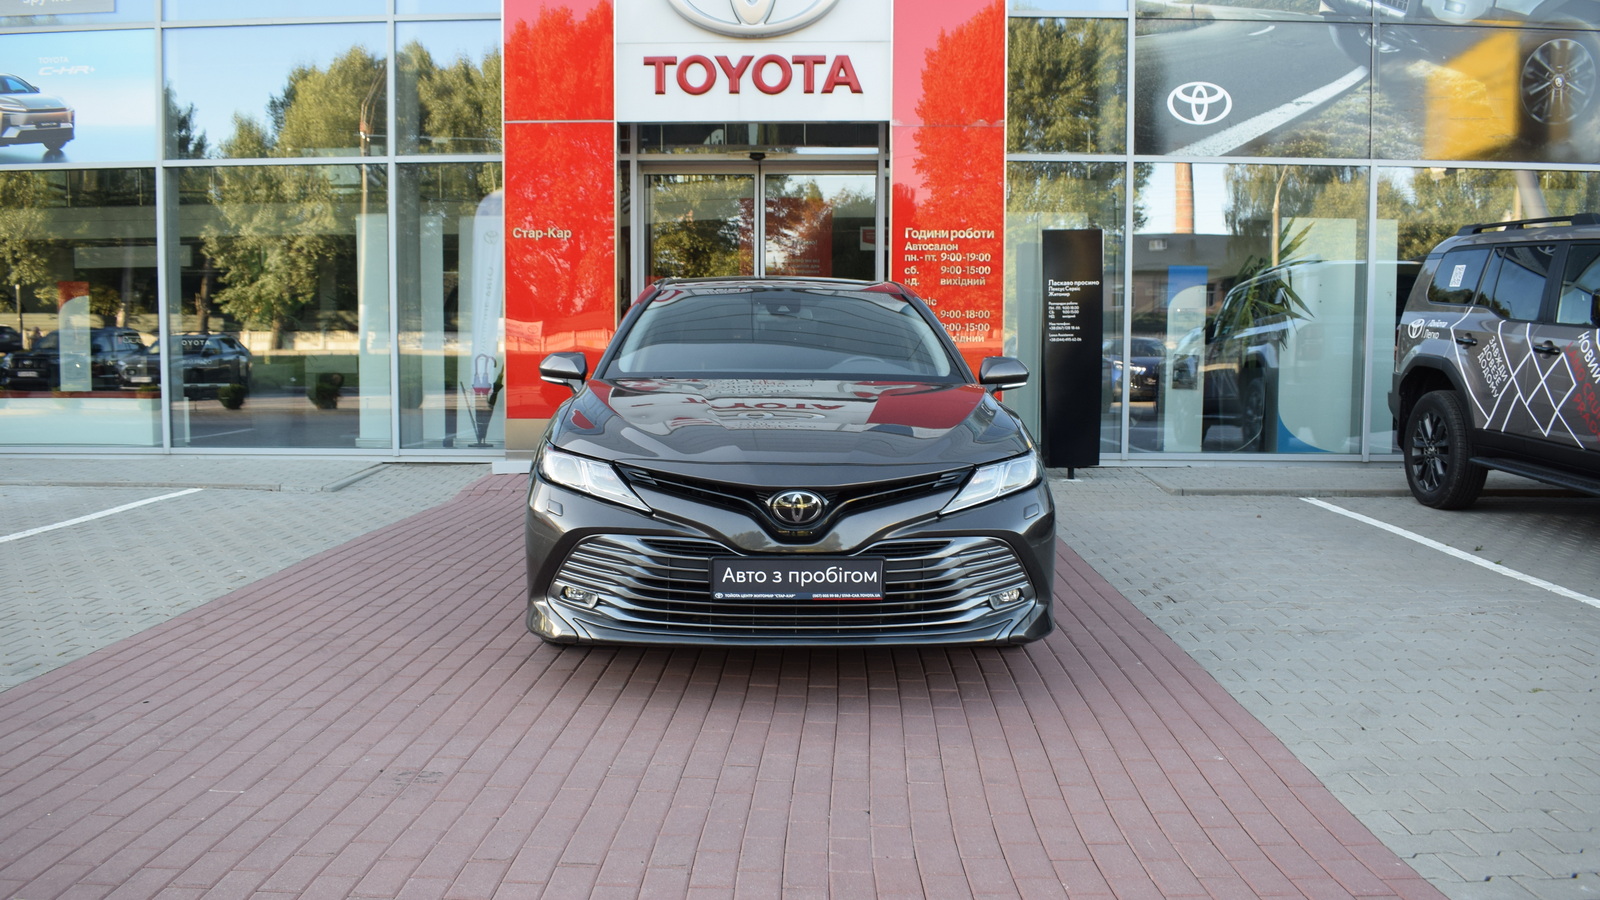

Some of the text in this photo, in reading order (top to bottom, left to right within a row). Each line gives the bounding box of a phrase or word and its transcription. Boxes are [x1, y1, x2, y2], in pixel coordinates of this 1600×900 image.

[643, 54, 864, 95] TOYOTA
[512, 228, 572, 240] Стар-Кар
[904, 228, 994, 240] Години роботи
[904, 242, 958, 251] Автосалон
[940, 253, 991, 262] 9:00-19:00
[904, 266, 991, 274] сб. 9:00-15:00
[940, 277, 986, 286] вихідний
[924, 296, 937, 306] віс
[940, 310, 990, 318] 9:00-18:00
[952, 333, 985, 342] хідний
[1424, 329, 1440, 339] Легко
[1488, 336, 1508, 382] ЗАВЖДИ
[1482, 345, 1502, 387] ДОВЕЗЕ
[1477, 352, 1499, 398] ДОДОМУ
[722, 566, 878, 587] Авто з пробігом
